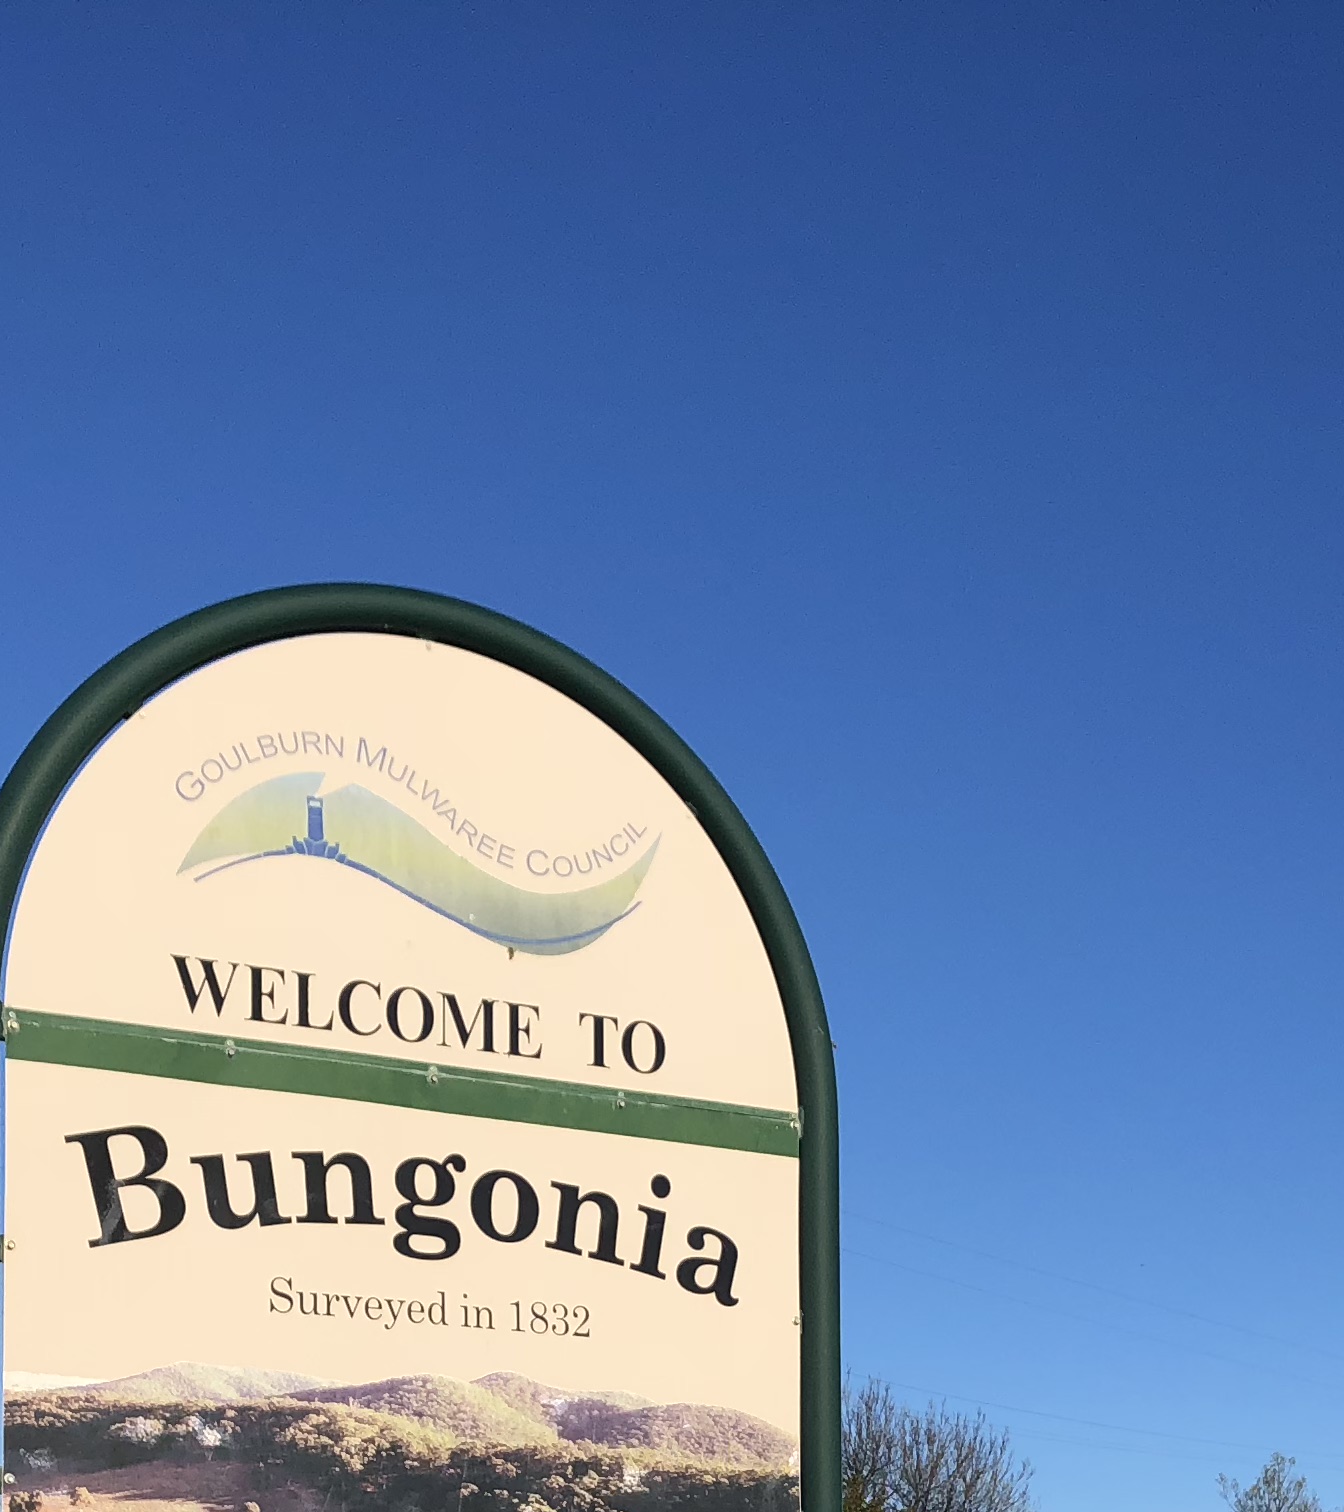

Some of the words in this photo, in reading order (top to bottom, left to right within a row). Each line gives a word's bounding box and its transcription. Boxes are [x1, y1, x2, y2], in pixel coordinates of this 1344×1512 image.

[170, 954, 544, 1060] WELCOME
[579, 1011, 667, 1074] TO
[64, 1125, 740, 1308] Bungonia
[269, 1276, 449, 1330] Surveyed
[460, 1294, 496, 1331] in
[510, 1300, 591, 1338] 1832
